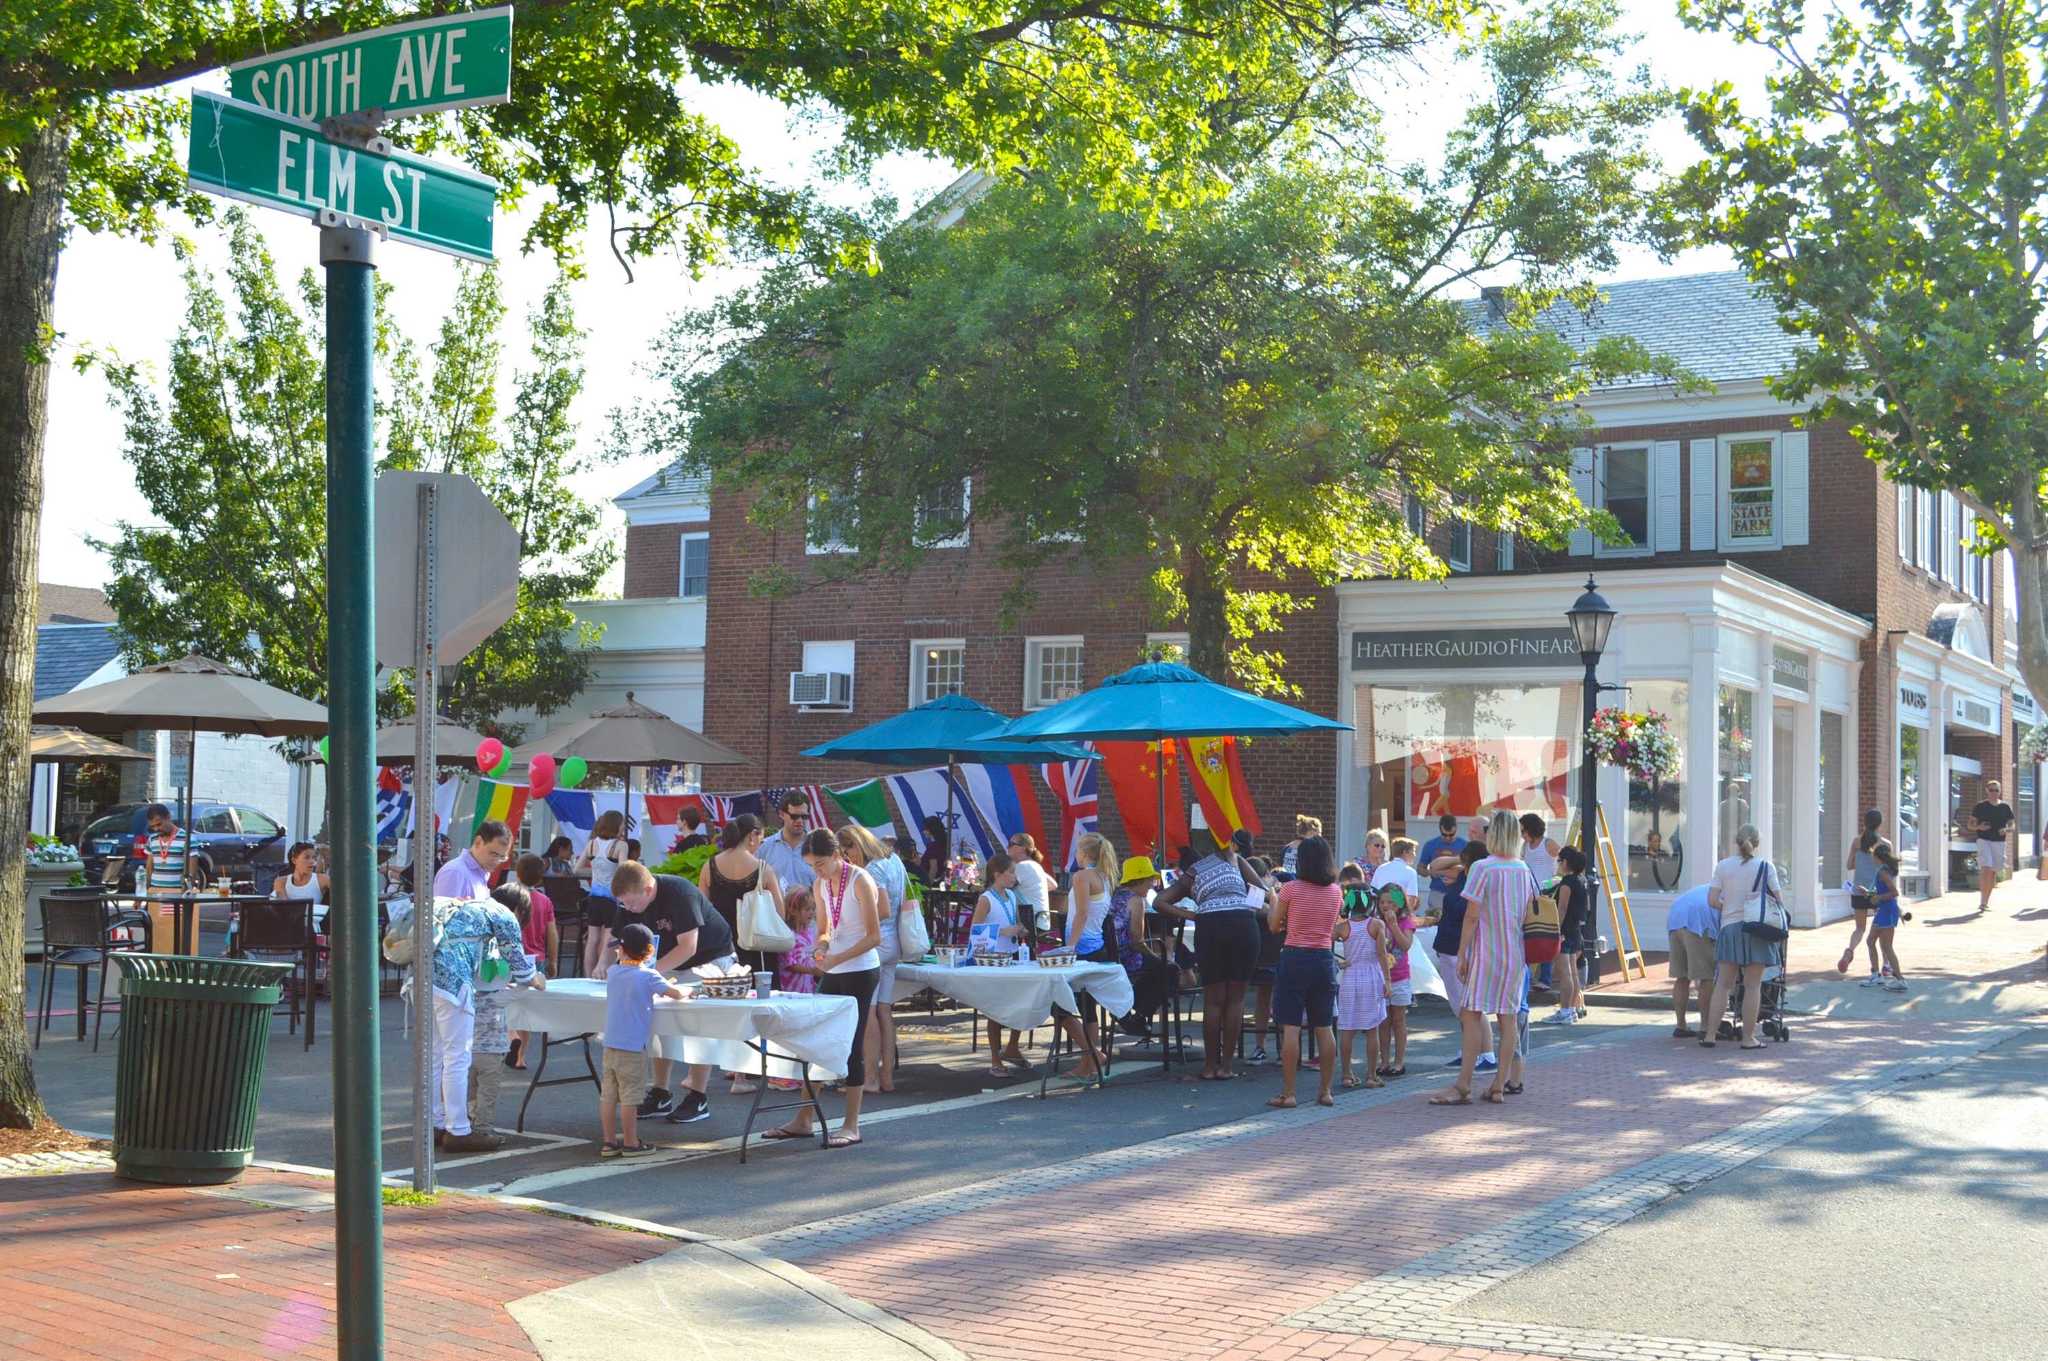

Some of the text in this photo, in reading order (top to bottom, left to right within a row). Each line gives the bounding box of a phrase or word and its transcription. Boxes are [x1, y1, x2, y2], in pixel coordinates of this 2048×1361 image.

[251, 28, 467, 122] SOUTH AVE
[277, 129, 426, 233] ELM ST
[1733, 505, 1772, 518] STATE
[1733, 519, 1770, 532] FARM
[1356, 638, 1577, 658] HEATHERGAUDIOFINEAR
